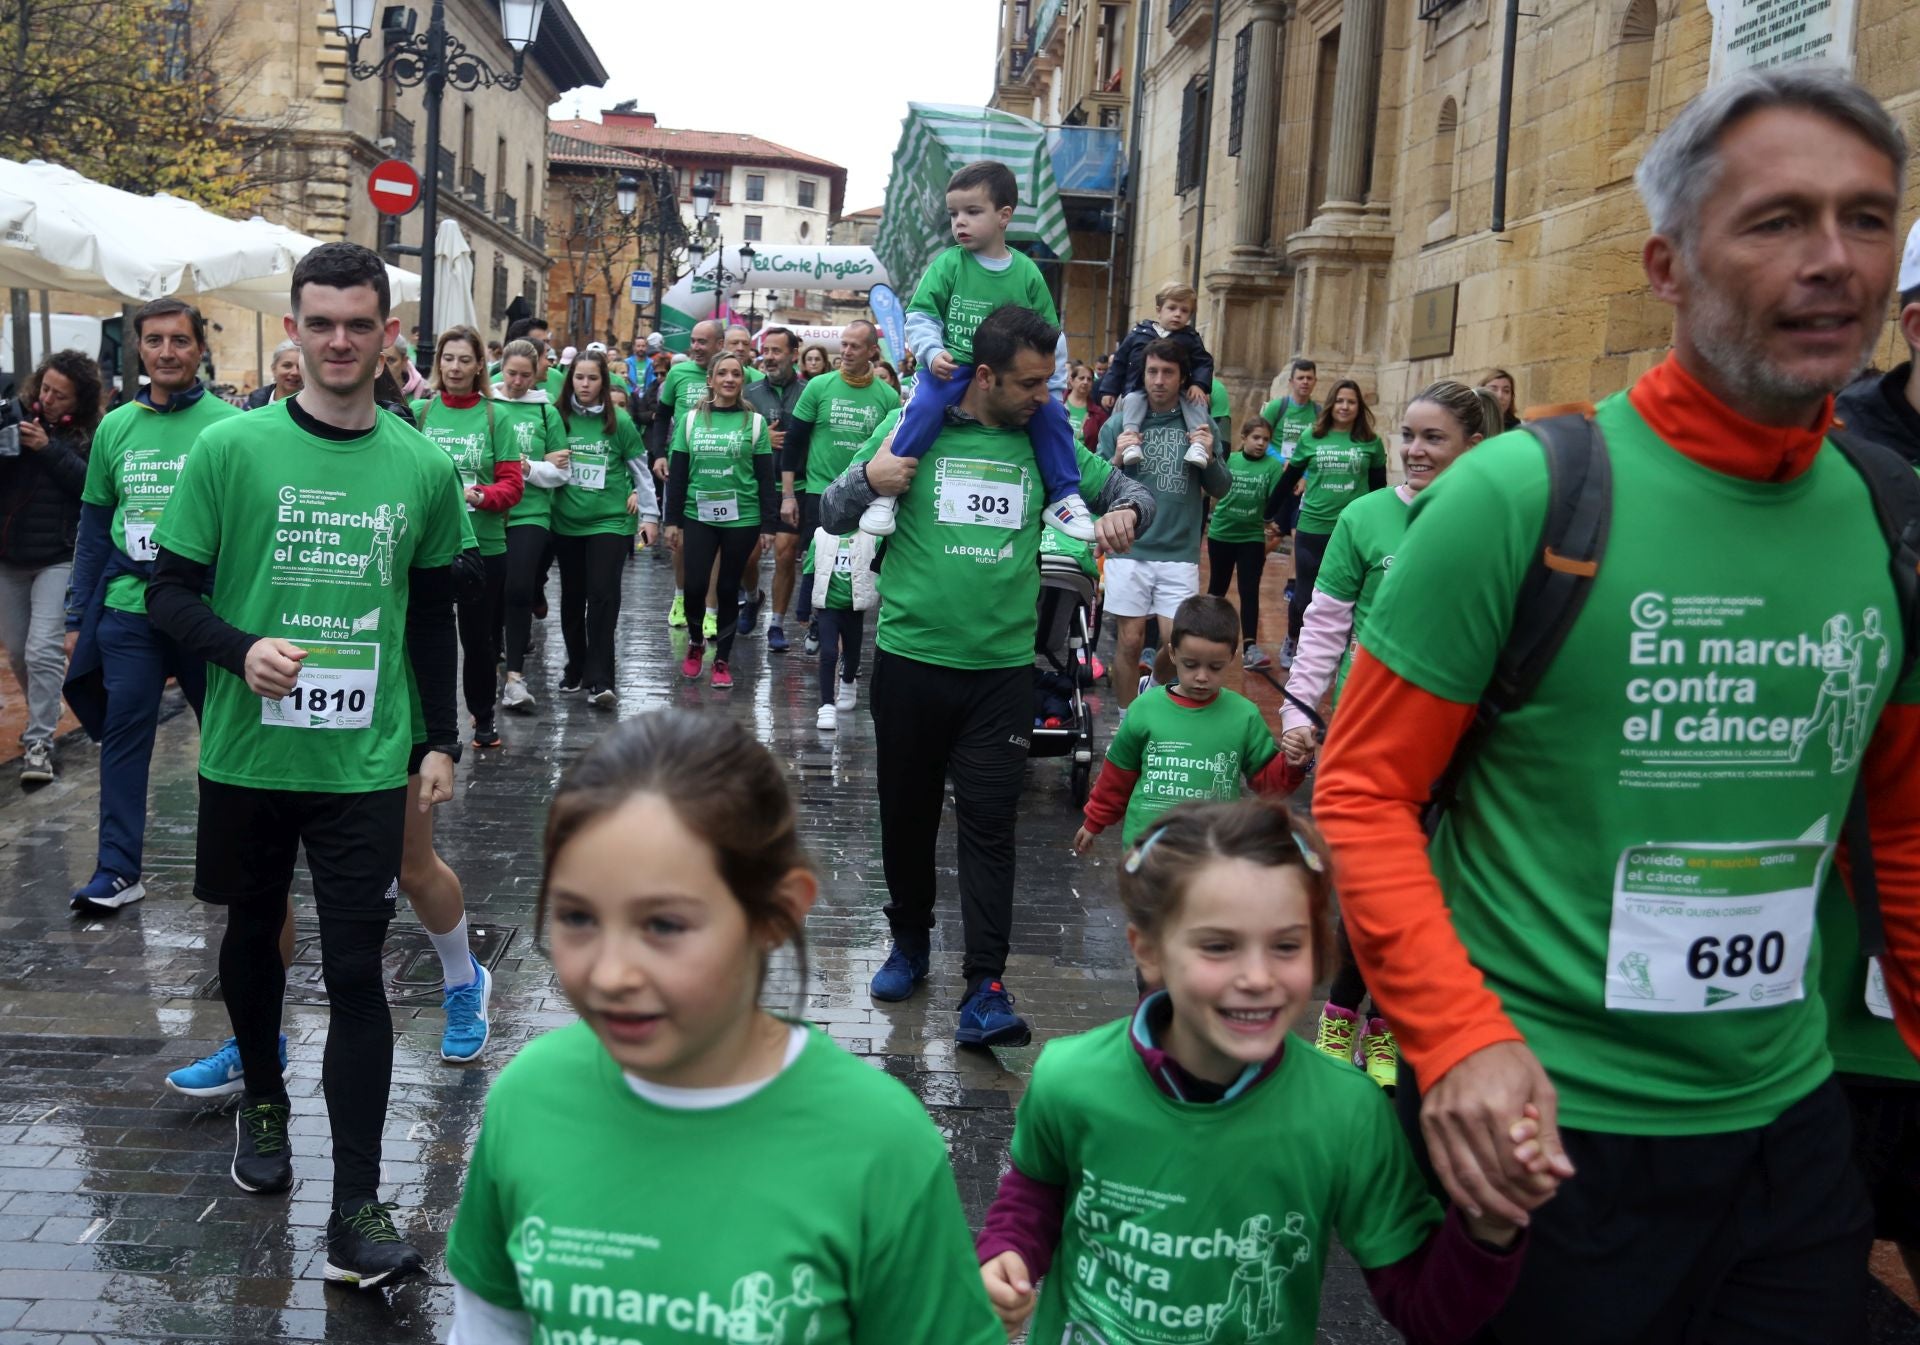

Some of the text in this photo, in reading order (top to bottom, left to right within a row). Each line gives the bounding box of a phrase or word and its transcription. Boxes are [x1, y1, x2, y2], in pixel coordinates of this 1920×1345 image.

[754, 252, 874, 280] El Corte Inglés
[949, 308, 966, 322] En
[796, 328, 841, 338] LABOR
[830, 411, 853, 419] contra
[1144, 443, 1179, 460] CAN
[124, 459, 184, 472] En marcha
[1137, 458, 1190, 476] EAGLE
[123, 471, 158, 483] contra
[1157, 475, 1188, 494] USA
[124, 482, 174, 495] el cáncer
[713, 507, 728, 516] 50
[967, 494, 1009, 515] 303
[278, 505, 385, 529] En marcha
[276, 528, 341, 546] contra
[274, 545, 369, 568] el cáncer
[944, 545, 997, 557] LABORAL
[1672, 607, 1702, 616] contra
[282, 613, 350, 630] LABORAL
[1672, 617, 1723, 627] en Asturias
[321, 630, 350, 640] kutxa
[337, 648, 361, 656] contra
[1629, 631, 1844, 667] En marcha
[1625, 670, 1756, 704] contra
[289, 687, 366, 713] 1810
[1622, 708, 1808, 743] el cáncer
[1147, 754, 1221, 772] En marcha
[1146, 769, 1189, 782] contra
[1143, 781, 1211, 799] el cáncer
[1630, 853, 1684, 867] Oviedo
[1688, 857, 1707, 868] en
[1759, 852, 1796, 866] contra
[1627, 870, 1699, 884] el cáncer
[1686, 930, 1786, 980] 680
[1119, 1219, 1258, 1260] marcha
[1077, 1254, 1223, 1328] el cáncer
[569, 1283, 757, 1341] marcha
